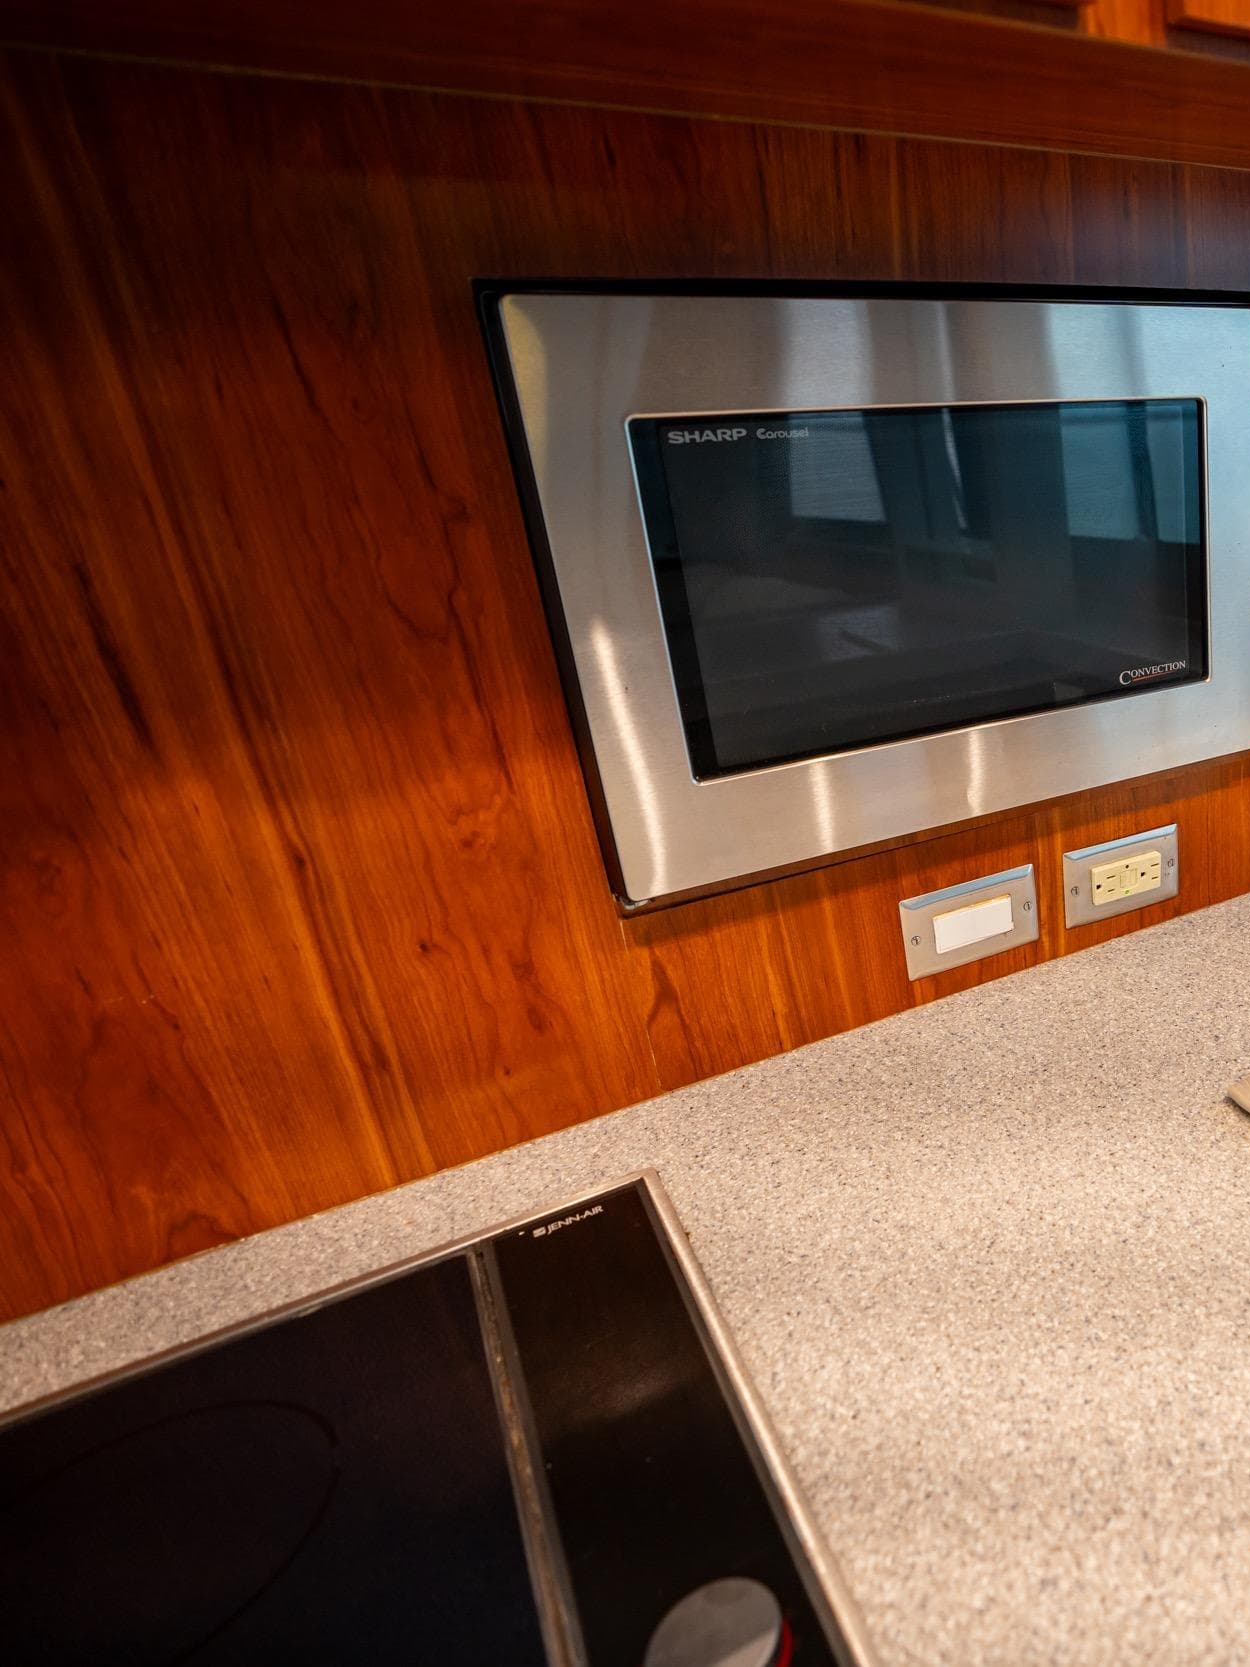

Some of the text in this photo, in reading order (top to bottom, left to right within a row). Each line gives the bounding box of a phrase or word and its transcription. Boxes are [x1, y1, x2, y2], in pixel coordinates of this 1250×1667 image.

[667, 427, 809, 444] SHARP Carousel
[1119, 660, 1186, 685] CONVECTION
[547, 1205, 604, 1235] JENN-AIR
